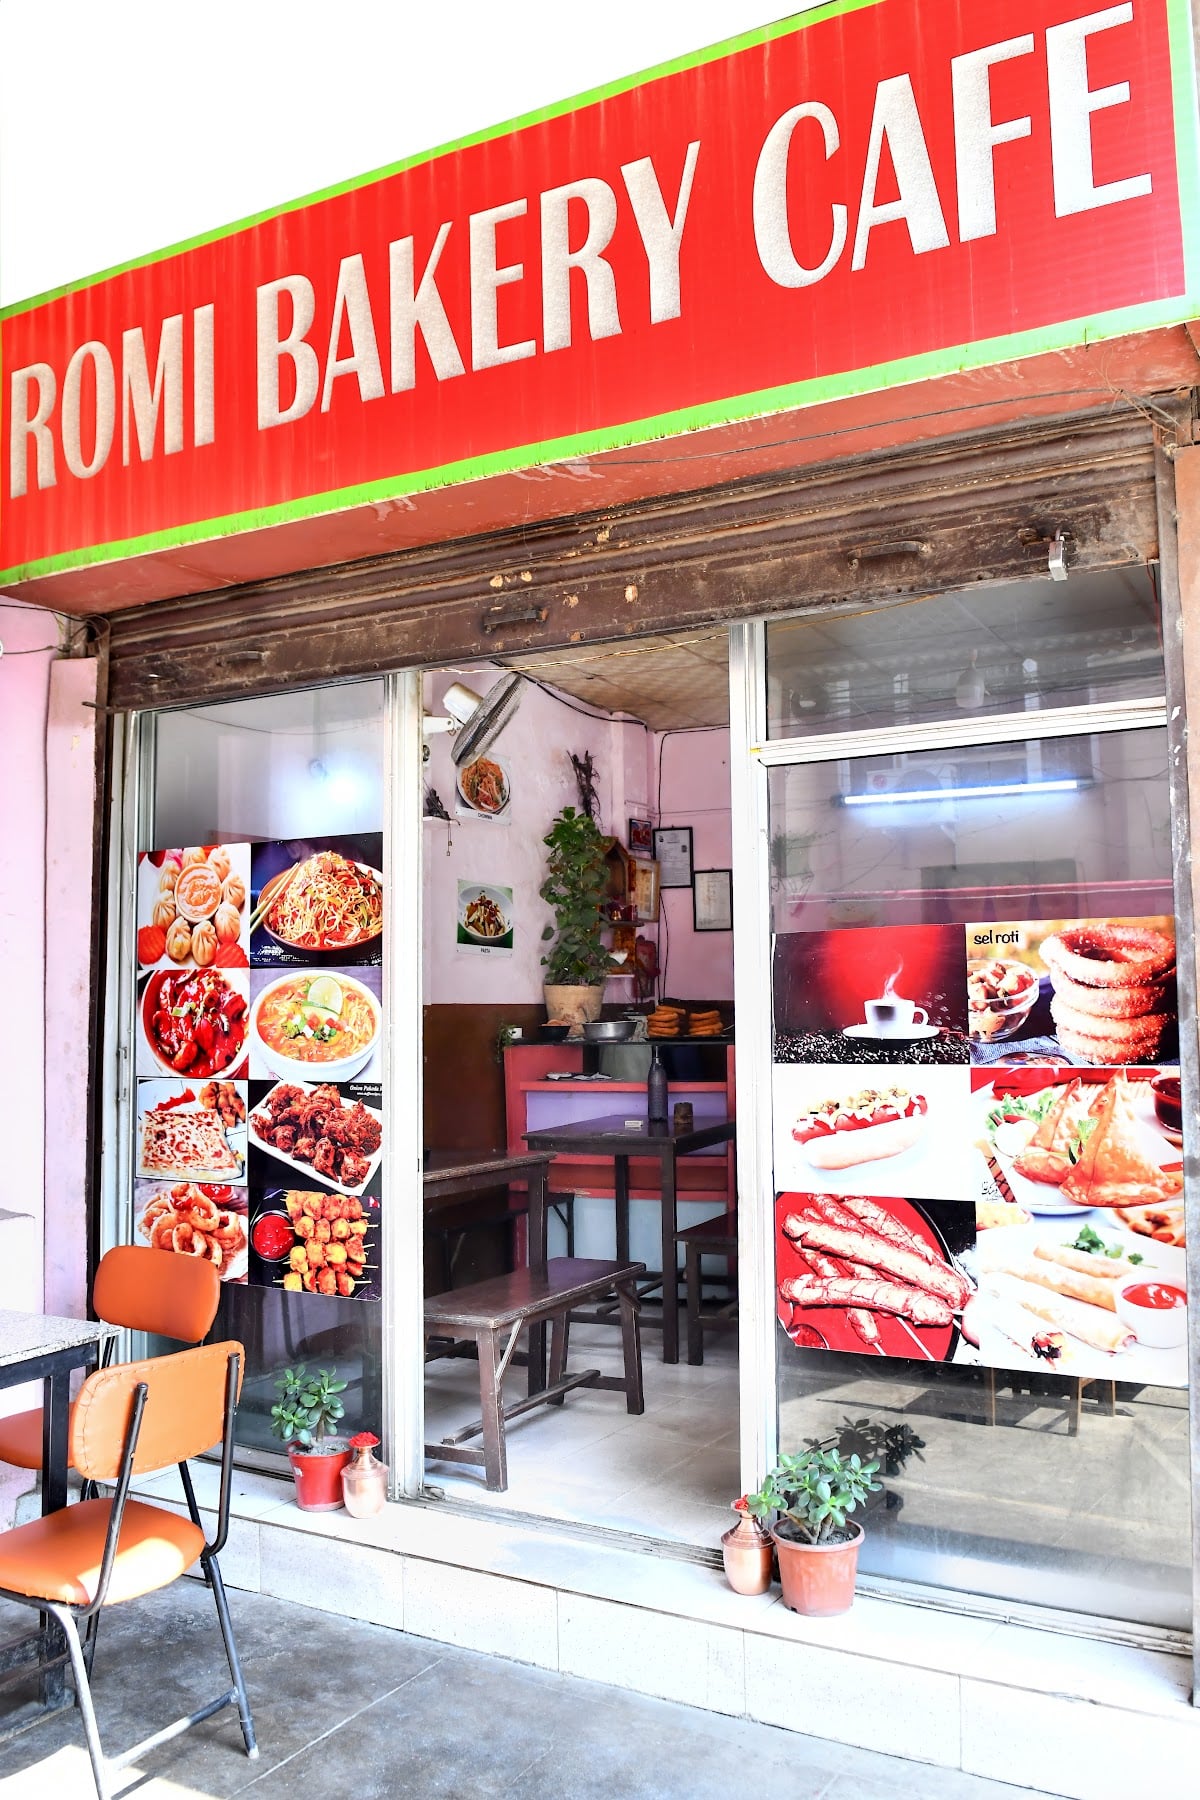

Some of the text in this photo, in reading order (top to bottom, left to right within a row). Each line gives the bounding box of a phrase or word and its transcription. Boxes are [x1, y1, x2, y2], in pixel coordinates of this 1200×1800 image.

[10, 1, 1153, 498] ROMI BAKERY CAFE
[973, 929, 1019, 945] sel roti
